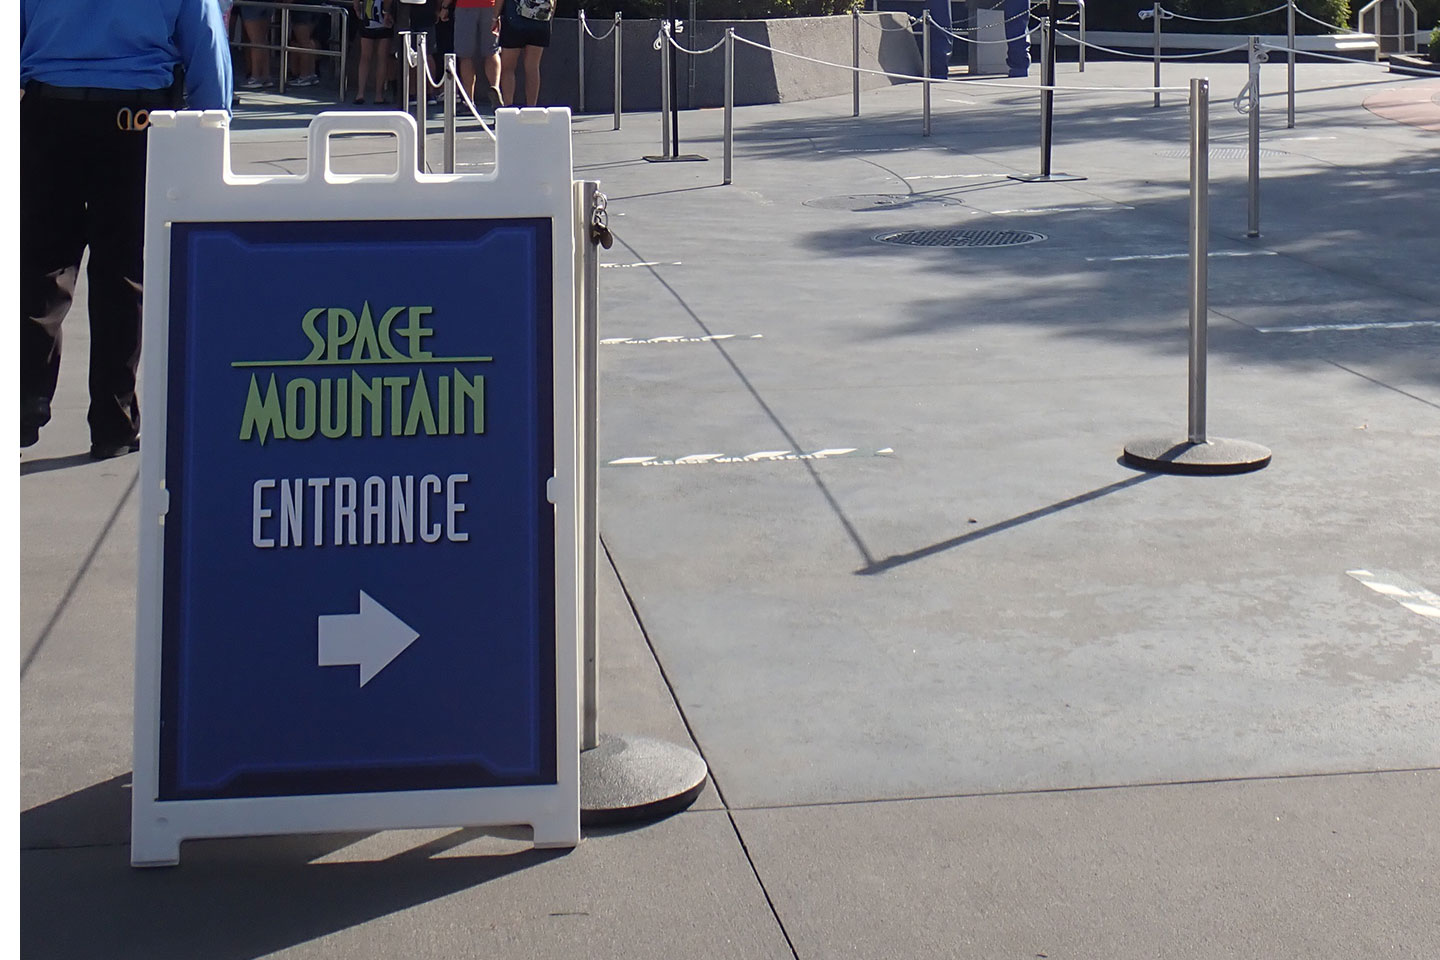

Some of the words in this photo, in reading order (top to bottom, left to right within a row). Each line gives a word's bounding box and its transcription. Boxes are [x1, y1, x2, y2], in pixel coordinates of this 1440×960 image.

[302, 300, 433, 361] SPACE
[239, 367, 485, 446] MOUNTAIN
[252, 473, 469, 549] ENTRANCE
